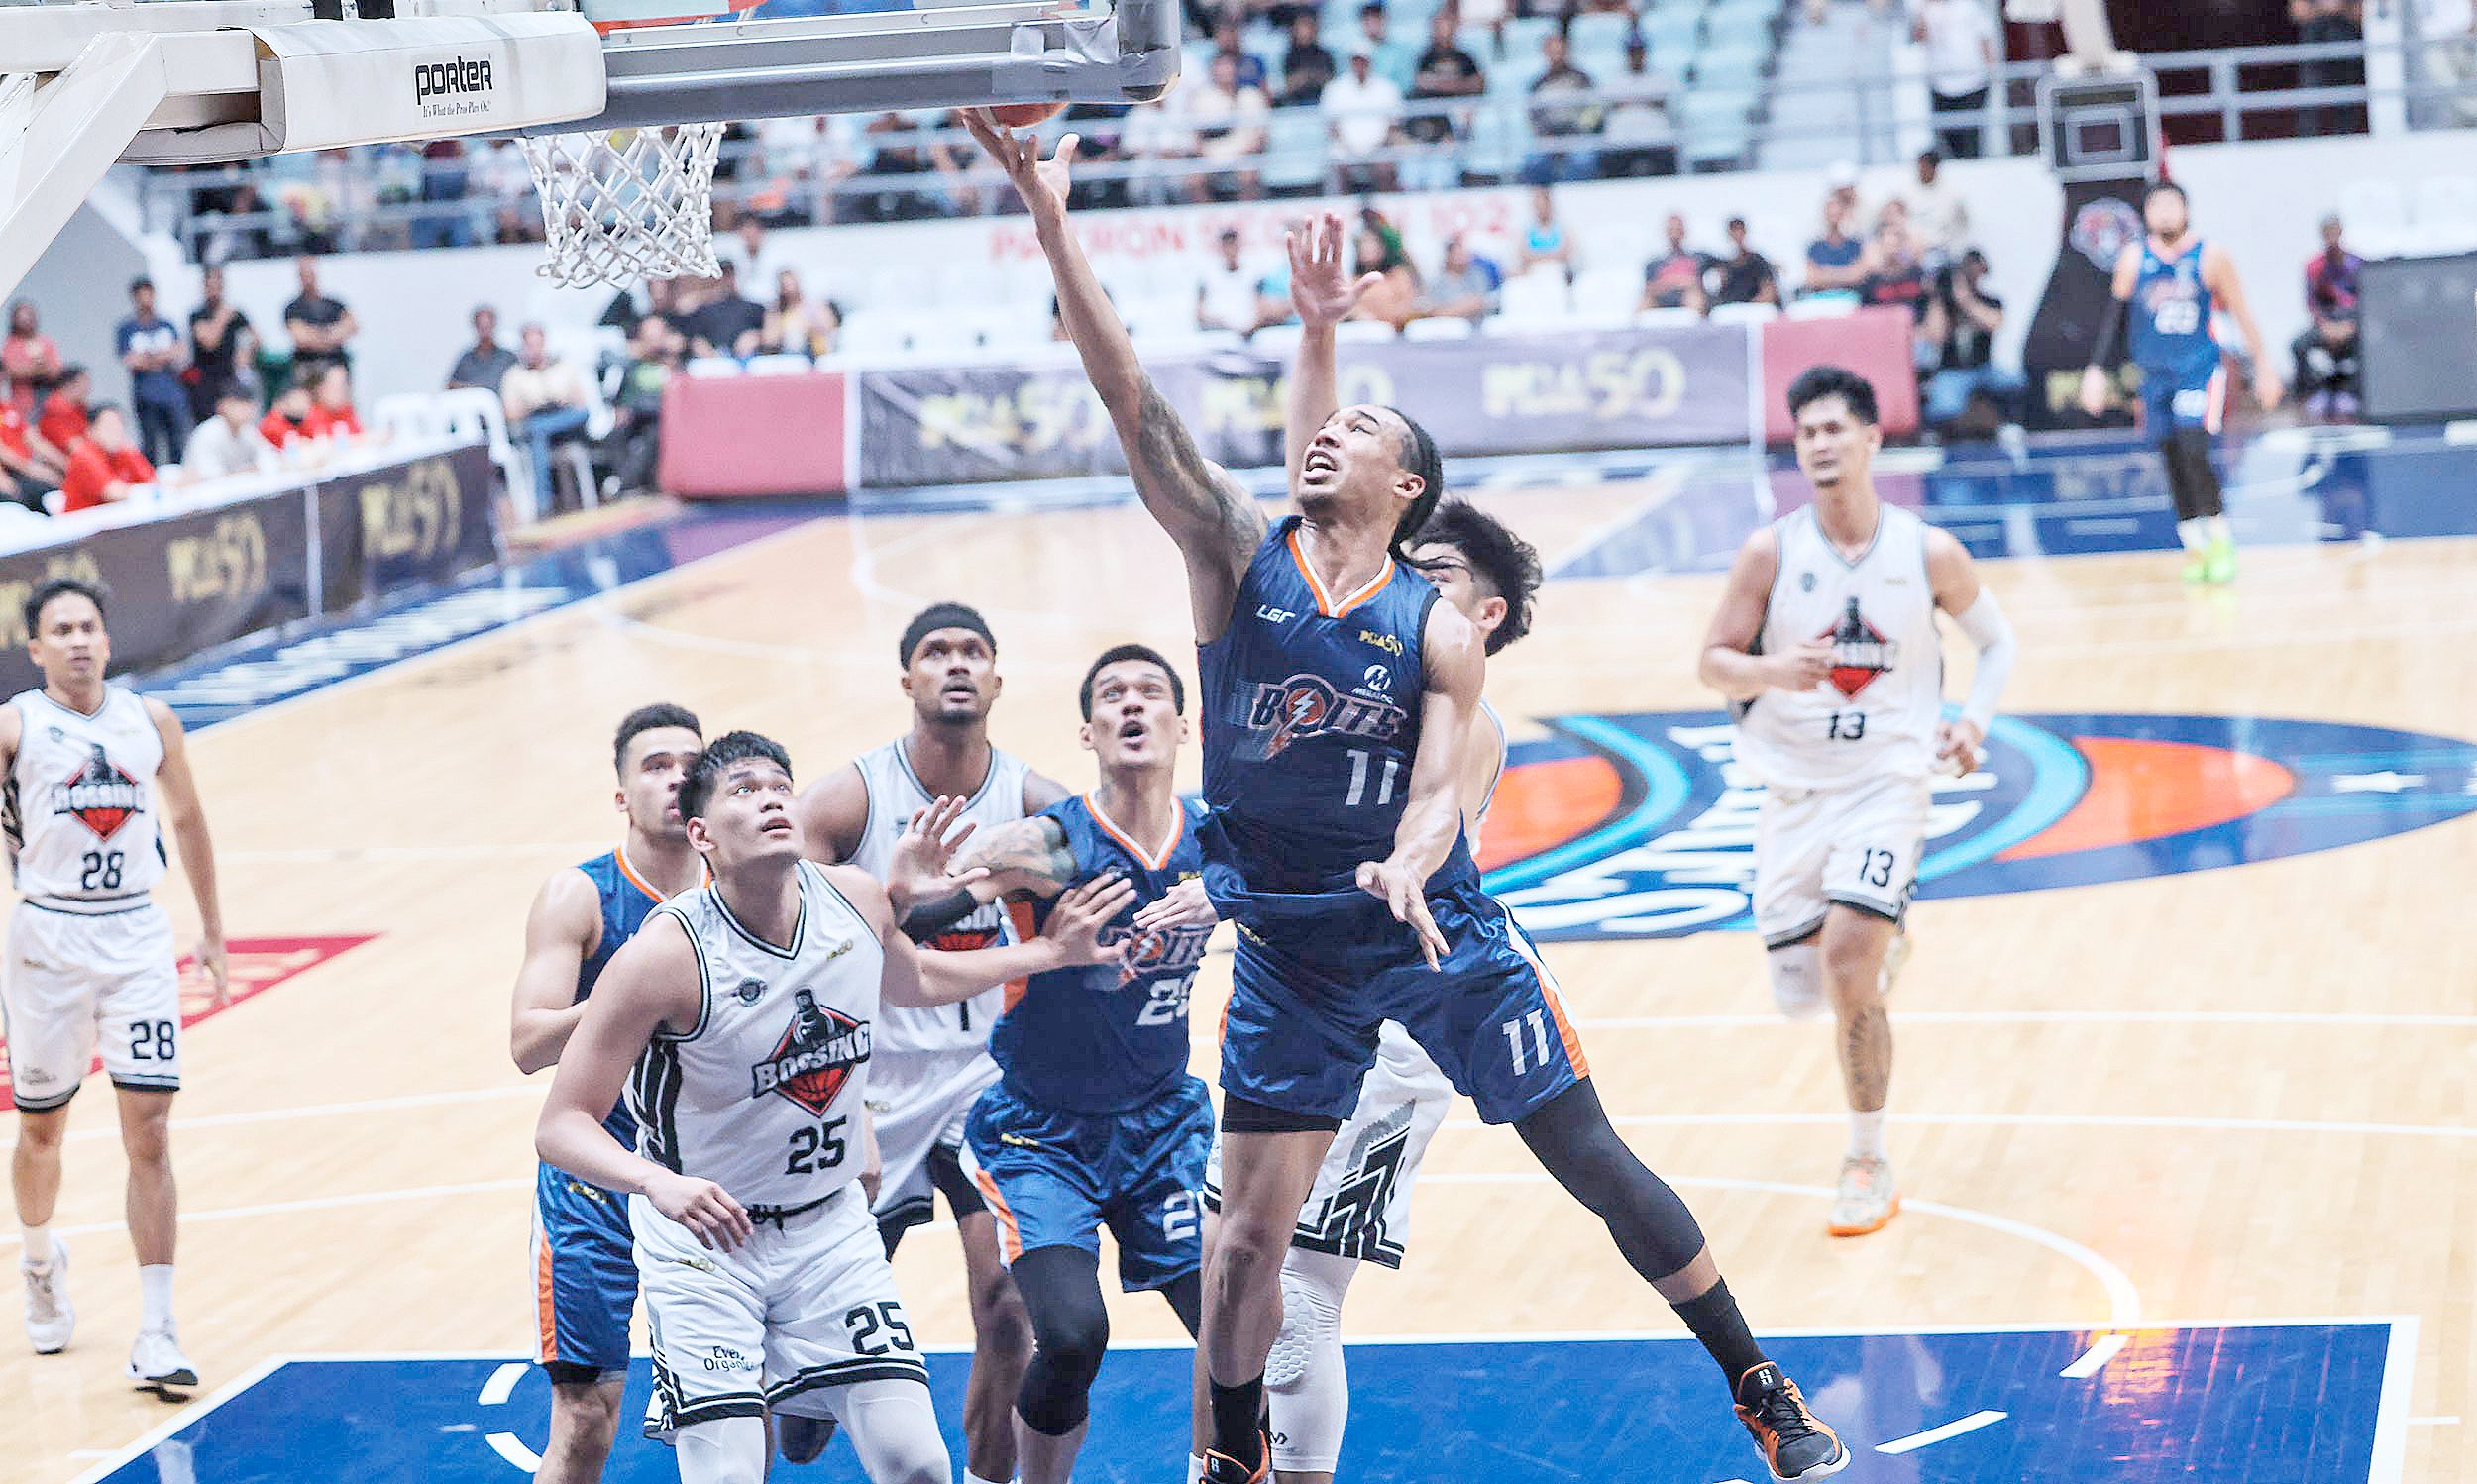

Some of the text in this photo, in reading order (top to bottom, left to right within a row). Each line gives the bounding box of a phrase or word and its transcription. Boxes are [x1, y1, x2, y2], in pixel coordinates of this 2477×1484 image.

[432, 103, 446, 116] What
[1828, 712, 1866, 740] 13
[1345, 749, 1399, 805] 11
[81, 851, 124, 890] 28
[1860, 847, 1894, 888] 13
[130, 1020, 175, 1060] 28
[1502, 1008, 1550, 1076] 11
[784, 1114, 847, 1175] 25
[845, 1301, 914, 1355] 25
